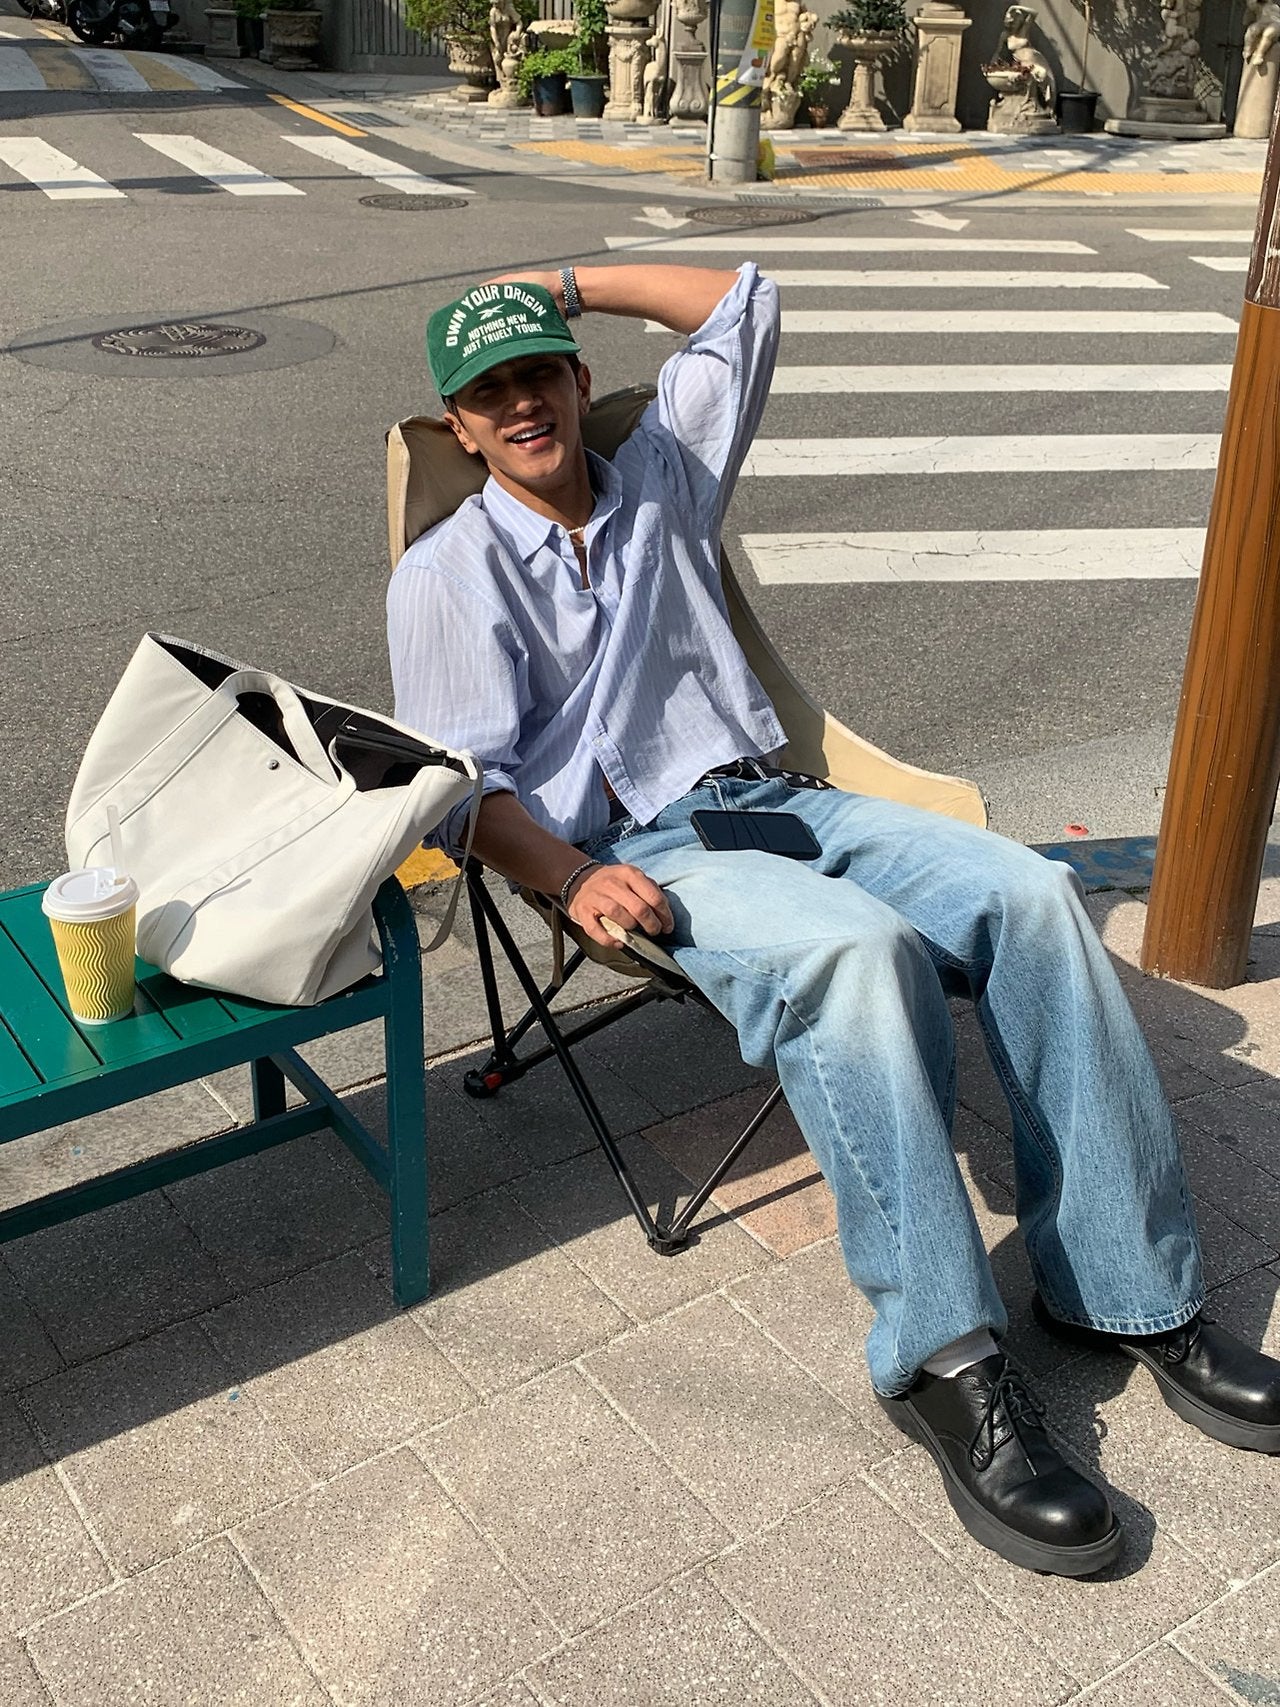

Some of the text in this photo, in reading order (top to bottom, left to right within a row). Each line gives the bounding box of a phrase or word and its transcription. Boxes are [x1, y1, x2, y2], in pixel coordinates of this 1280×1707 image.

[446, 285, 547, 347] OWN YOUR ORIGIN
[468, 313, 527, 341] NOTHING NEW
[463, 323, 543, 358] JUST TRUELY YOURS
